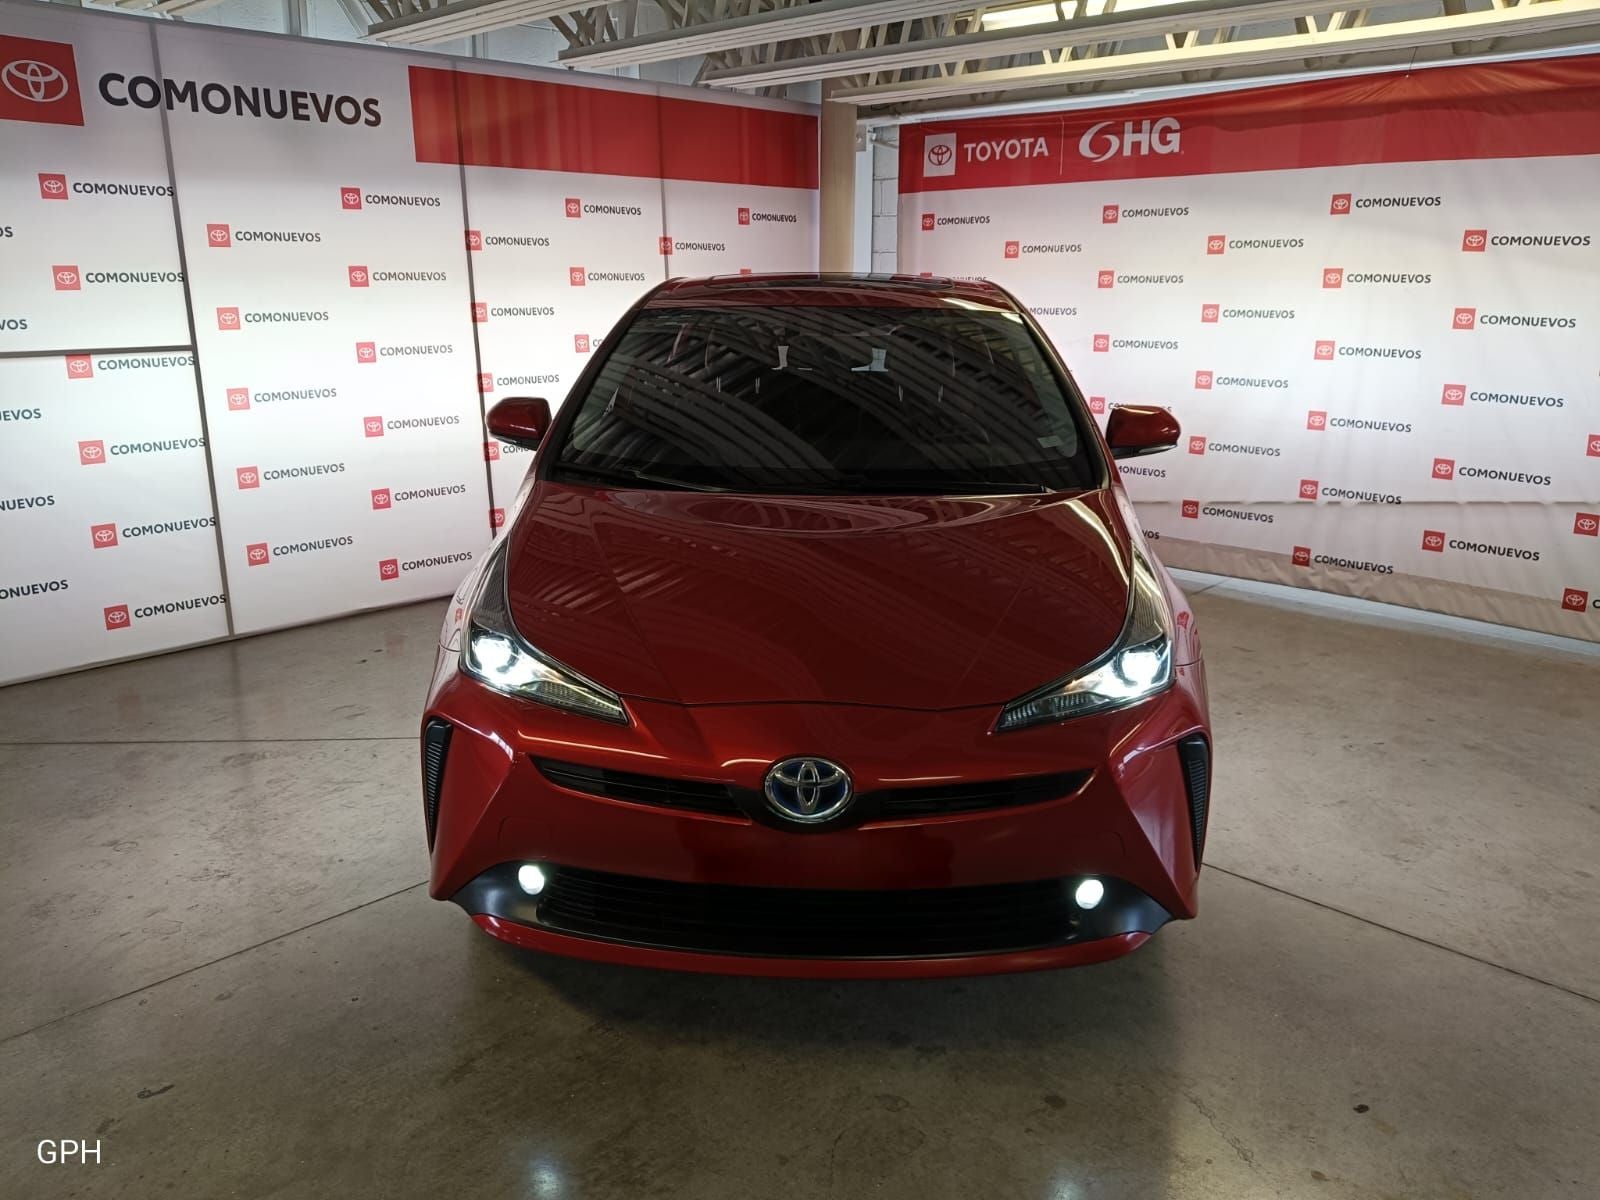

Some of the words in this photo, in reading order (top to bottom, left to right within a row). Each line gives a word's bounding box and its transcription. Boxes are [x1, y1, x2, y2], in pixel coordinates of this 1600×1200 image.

[98, 72, 382, 127] COMONUEVOS
[964, 137, 1049, 162] TOYOTA
[72, 181, 175, 197] COMONUEVOS
[365, 194, 441, 207] COMONUEVOS
[1355, 196, 1441, 209] COMONUEVOS
[583, 204, 642, 216] COMONUEVOS
[1121, 206, 1190, 218] COMONUEVOS
[751, 212, 798, 223] COMONUEVOS
[937, 215, 991, 226] COMONUEVOS
[234, 230, 321, 243] COMONUEVOS
[484, 236, 550, 247] COMONUEVOS
[1228, 238, 1304, 249] COMONUEVOS
[1490, 235, 1591, 246] COMONUEVOS
[674, 242, 726, 252] COMONUEVOS
[1021, 243, 1082, 254] COMONUEVOS
[85, 271, 185, 284] COMONUEVOS
[372, 271, 447, 282] COMONUEVOS
[587, 272, 646, 282] COMONUEVOS
[1116, 274, 1184, 284] COMONUEVOS
[1346, 273, 1432, 284] COMONUEVOS
[244, 311, 329, 323] COMONUEVOS
[490, 306, 555, 317] COMONUEVOS
[1029, 306, 1078, 317] MONUEVOS
[1222, 308, 1296, 320] COMONUEVOS
[1479, 314, 1577, 329] COMONUEVOS
[379, 344, 453, 357] COMONUEVOS
[1112, 339, 1179, 350] COMONUEVOS
[1338, 346, 1422, 360] COMONUEVOS
[97, 355, 196, 371] COMONUEVOS
[496, 374, 560, 387] COMONUEVOS
[1215, 376, 1289, 389] COMONUEVOS
[253, 387, 337, 403] COMONUEVOS
[1469, 391, 1564, 408] COMONUEVOS
[386, 415, 460, 430] COMONUEVOS
[1329, 417, 1412, 433] COMONUEVOS
[110, 437, 207, 456] COMONUEVOS
[1208, 442, 1281, 457] COMONUEVOS
[263, 462, 345, 481] COMONUEVOS
[1119, 465, 1166, 479] ONUEVOS
[1458, 466, 1552, 486] COMONUEVOS
[394, 483, 466, 502] COMONUEVOS
[1321, 487, 1402, 505] COMONUEVOS
[0, 495, 55, 512] NUEVOS
[1202, 506, 1274, 524] COMONUEVOS
[121, 516, 217, 539] COMONUEVOS
[272, 535, 354, 557] COMONUEVOS
[1448, 539, 1540, 562] COMONUEVOS
[401, 551, 473, 571] COMONUEVOS
[1314, 554, 1394, 575] COMONUEVOS
[0, 579, 69, 600] ONUEVOS
[133, 593, 227, 619] COMONUEVOS
